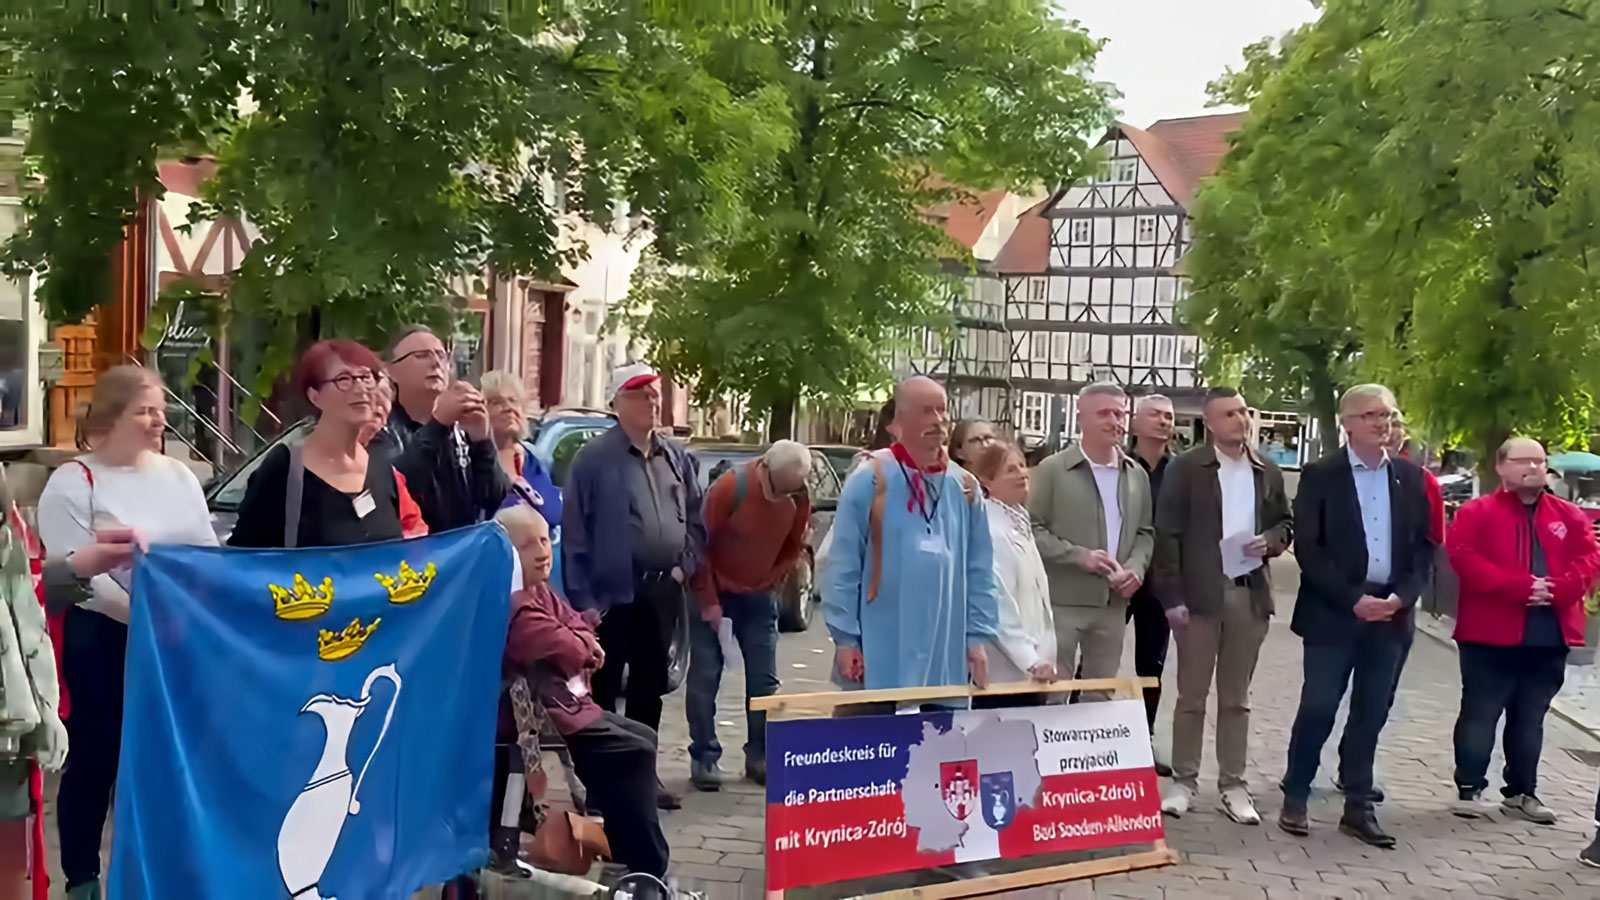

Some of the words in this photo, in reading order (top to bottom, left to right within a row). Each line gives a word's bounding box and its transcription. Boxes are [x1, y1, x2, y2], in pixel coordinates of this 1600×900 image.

[784, 744, 876, 767] Freundeskreis
[878, 742, 897, 759] für
[784, 790, 806, 807] die
[808, 779, 897, 804] Partnerschaft
[1042, 782, 1137, 808] Krynica-Zdrój
[1139, 781, 1145, 798] i
[775, 829, 801, 851] mit
[805, 816, 907, 848] Krynica-Zdrój
[1033, 822, 1056, 842] Bad
